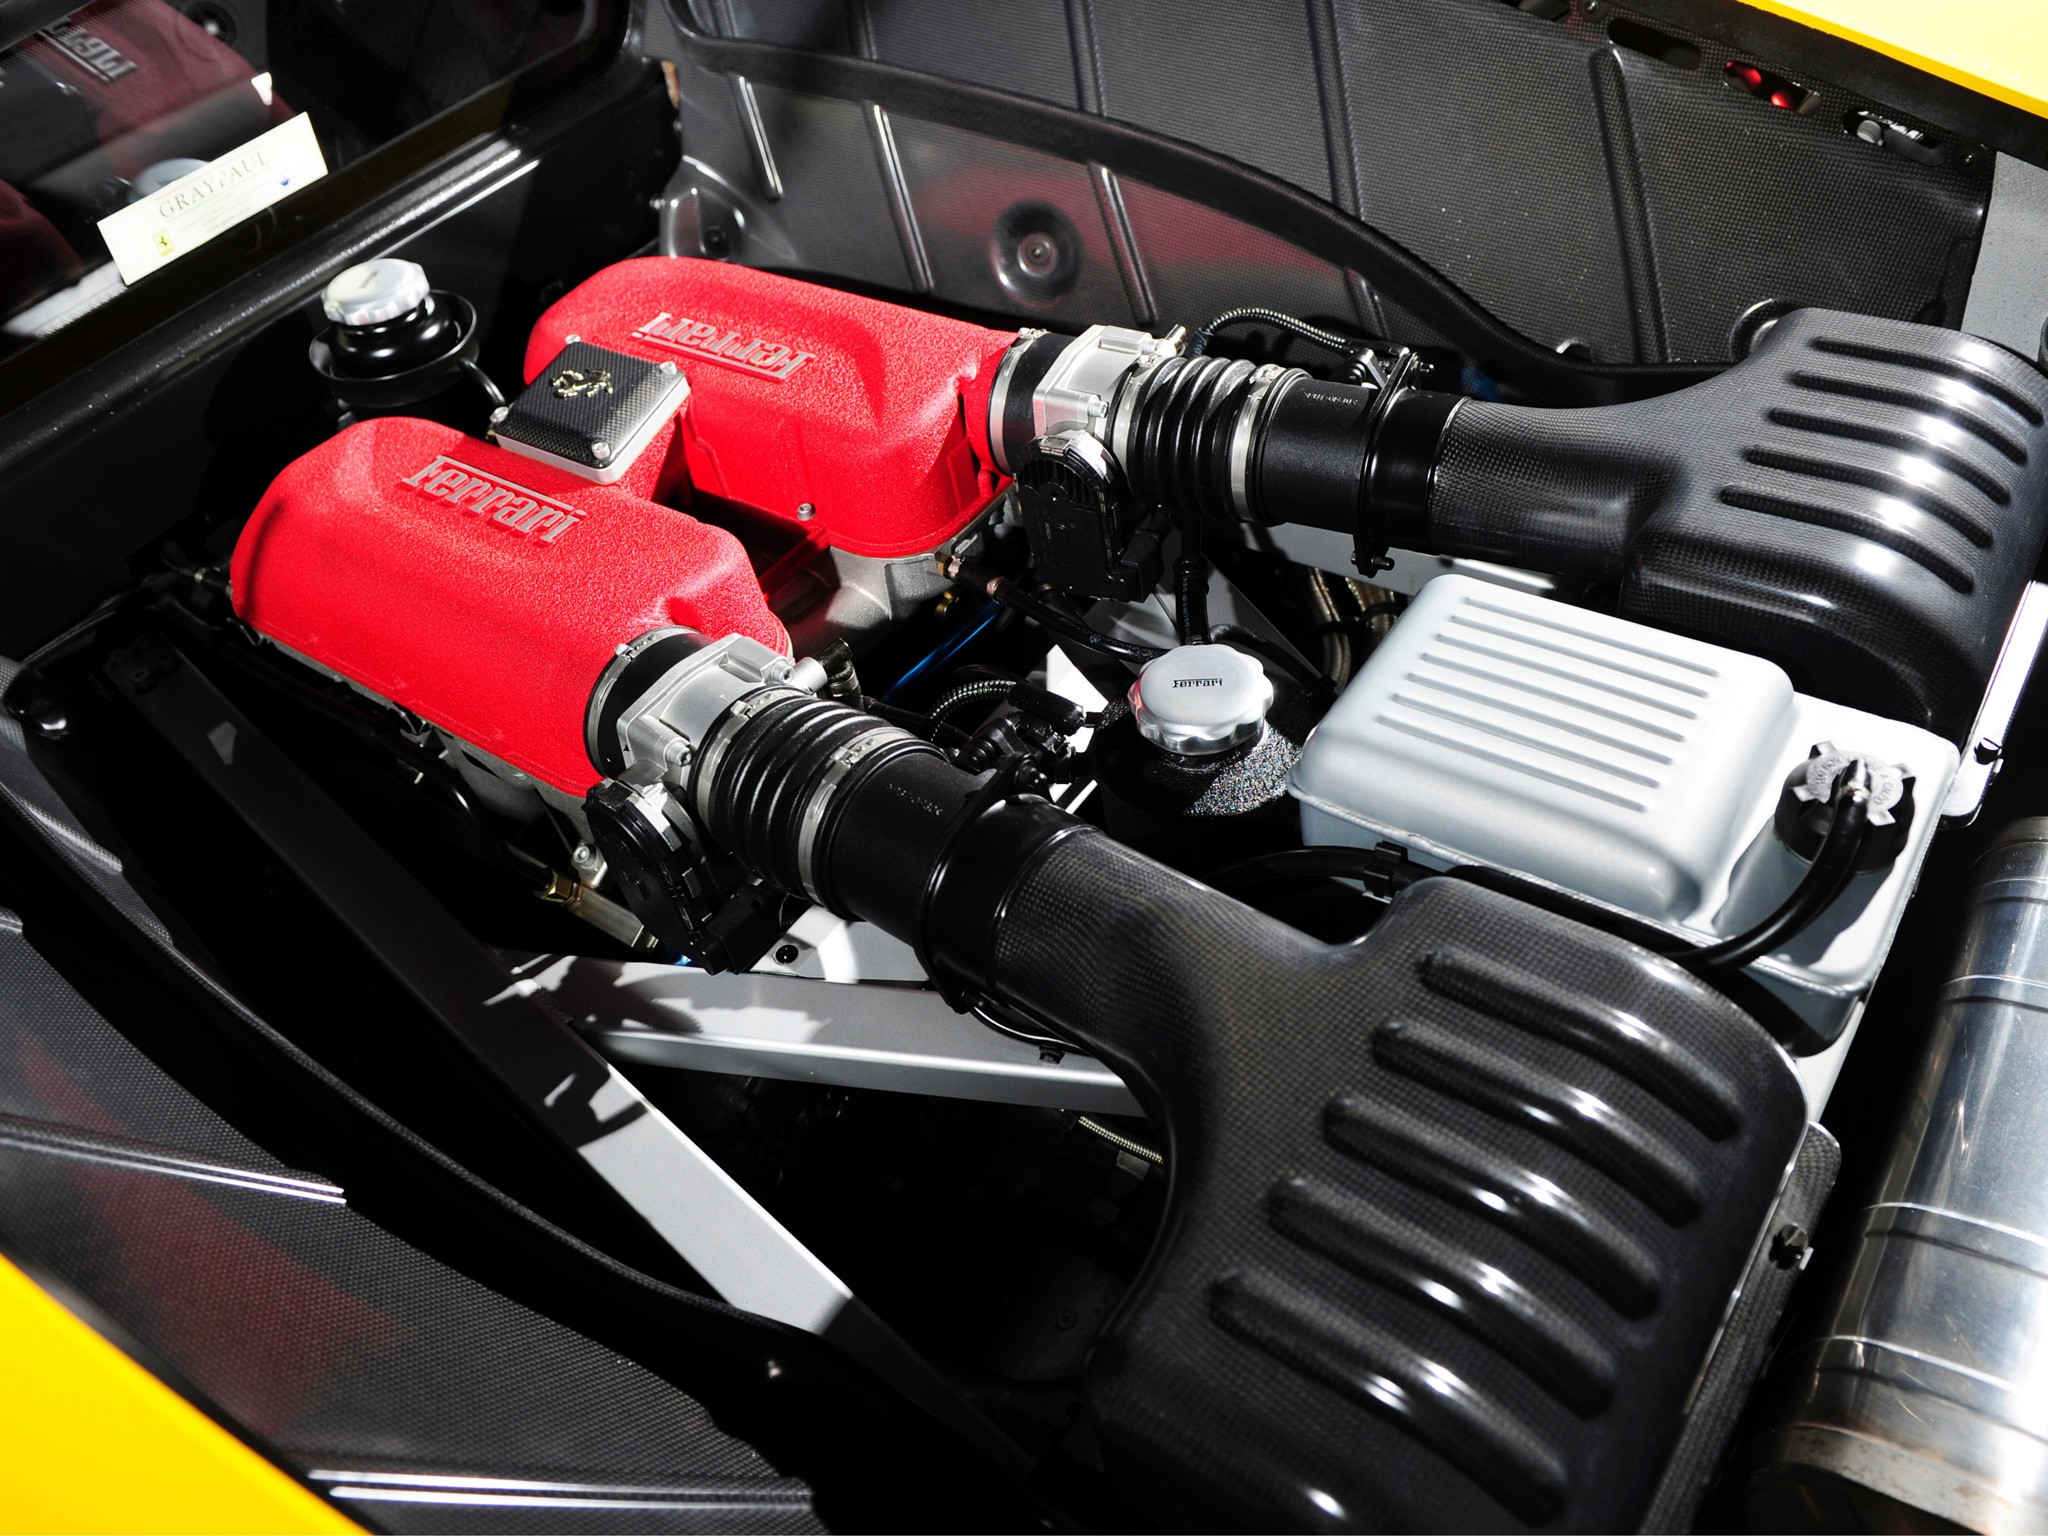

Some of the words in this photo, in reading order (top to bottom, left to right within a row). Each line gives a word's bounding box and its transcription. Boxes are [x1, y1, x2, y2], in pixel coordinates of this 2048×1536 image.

[631, 312, 818, 379] Ferrari
[401, 455, 588, 542] Ferrari
[1172, 678, 1222, 688] Ferrari
